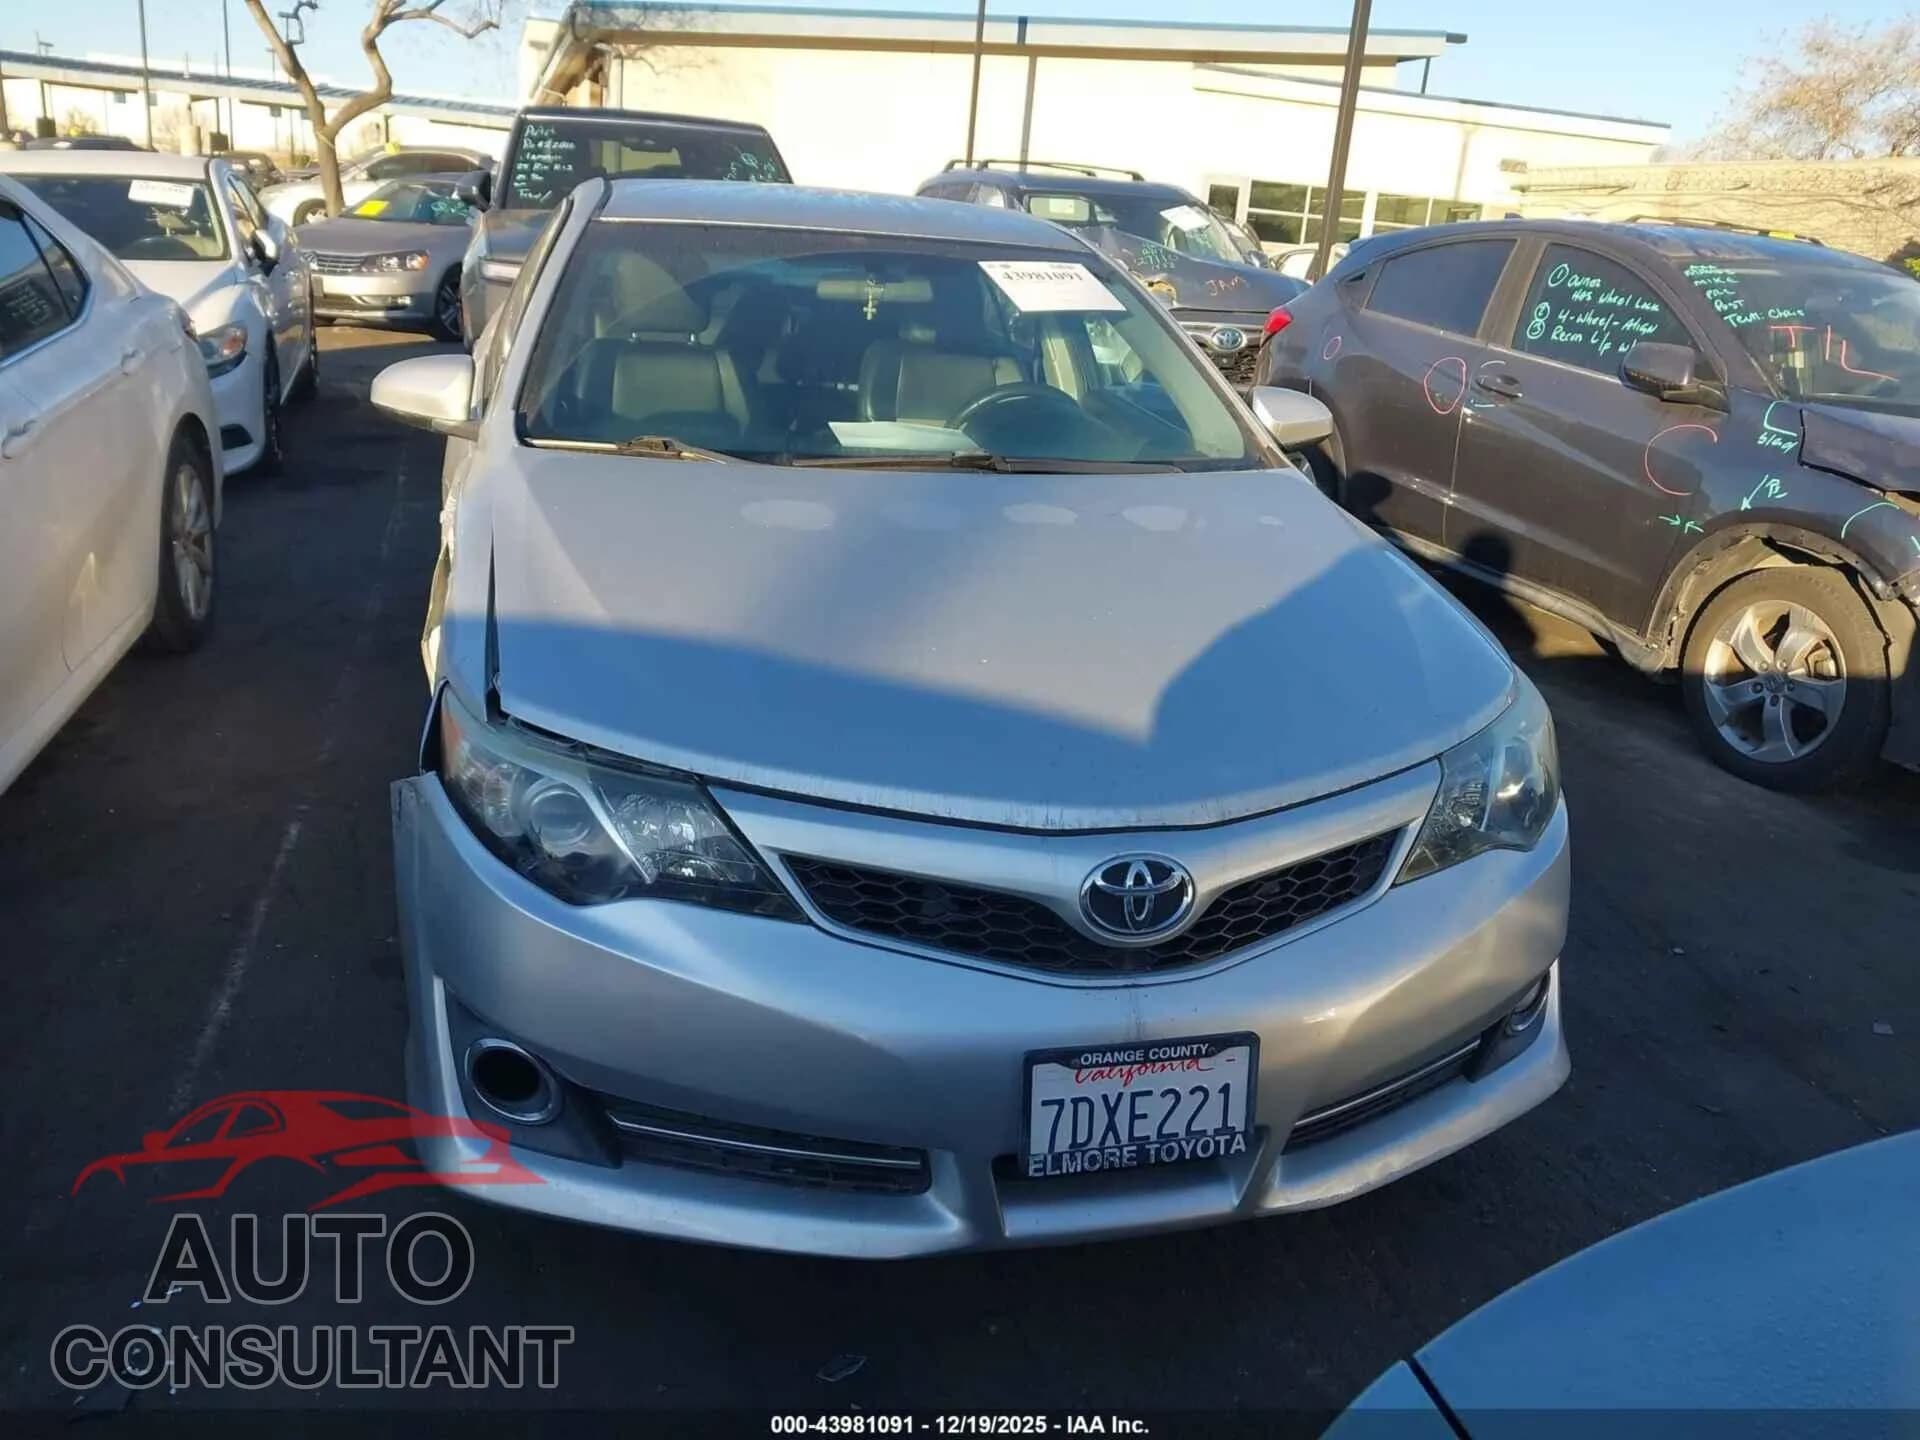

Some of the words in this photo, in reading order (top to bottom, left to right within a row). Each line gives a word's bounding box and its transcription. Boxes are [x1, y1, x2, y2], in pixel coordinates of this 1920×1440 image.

[1080, 1051, 1145, 1067] ORANGE
[1149, 1043, 1210, 1060] COUNTY
[1040, 1082, 1236, 1155] 7DXE221
[1028, 1145, 1138, 1177] ELMORE
[1142, 1133, 1247, 1164] TOYOTA
